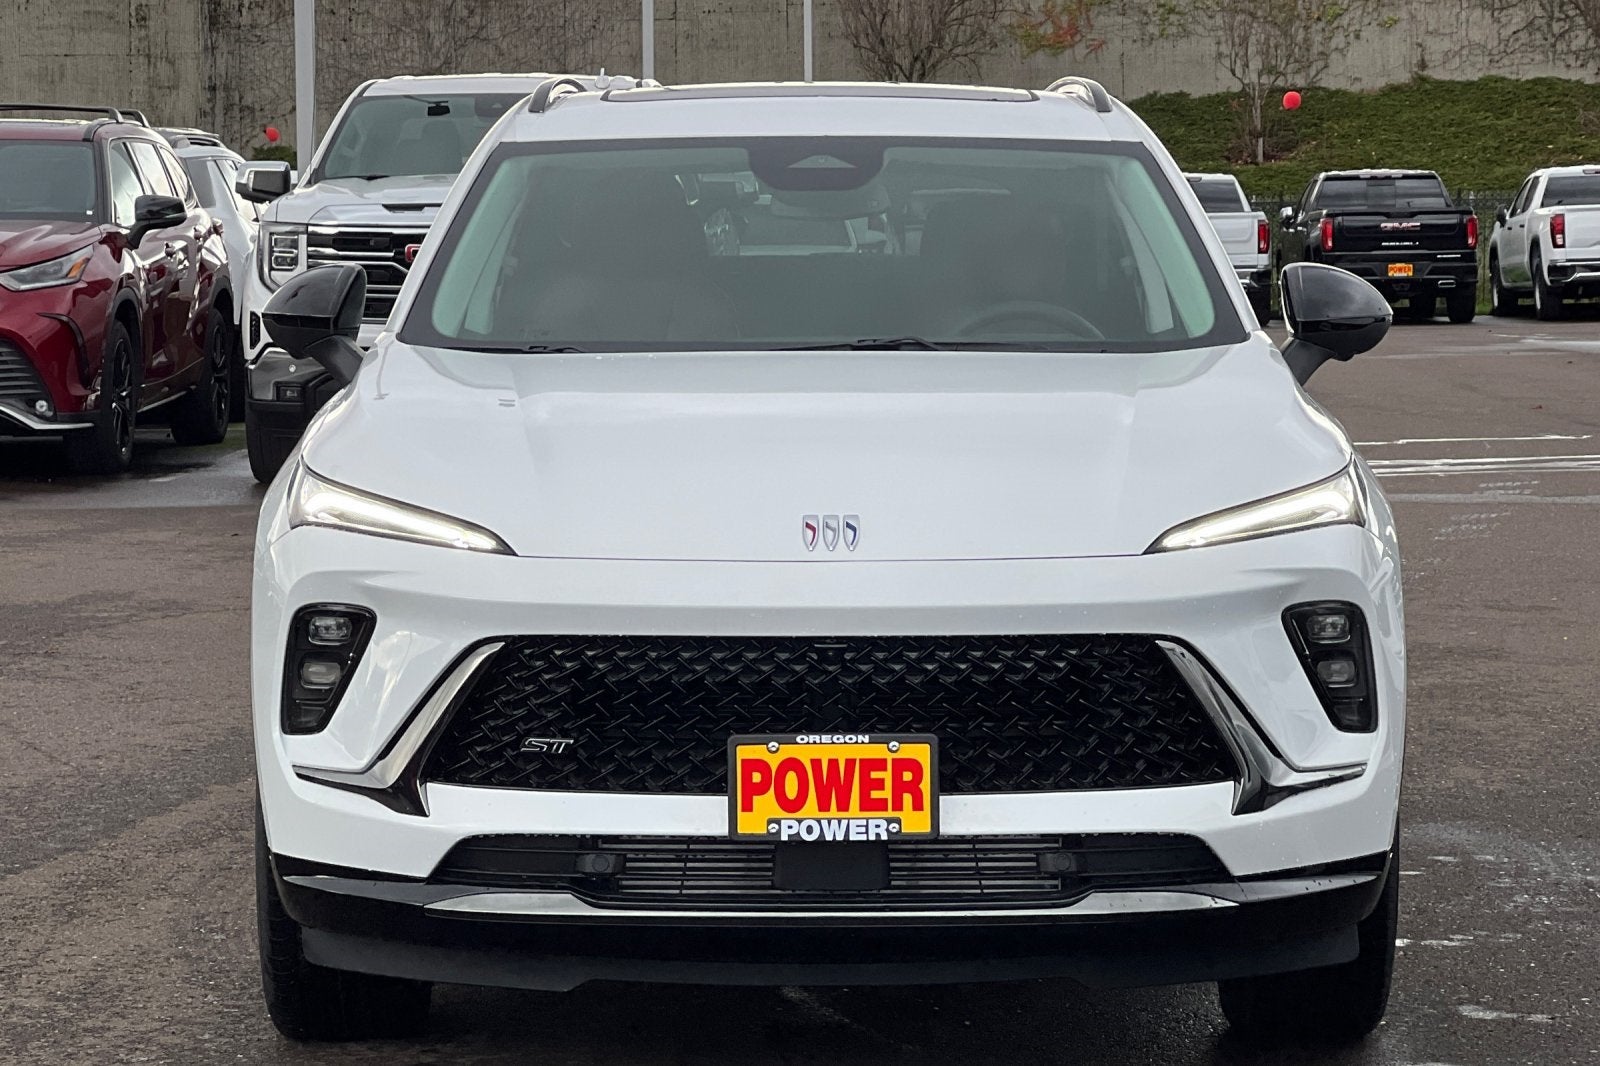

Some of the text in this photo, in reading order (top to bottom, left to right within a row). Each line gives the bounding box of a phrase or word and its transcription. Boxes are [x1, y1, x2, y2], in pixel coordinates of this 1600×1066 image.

[1380, 222, 1421, 231] GMC
[1389, 265, 1412, 274] POWER
[520, 737, 574, 754] ST
[795, 734, 870, 744] OREGON
[740, 757, 924, 814] POWER
[780, 819, 888, 842] POWER
